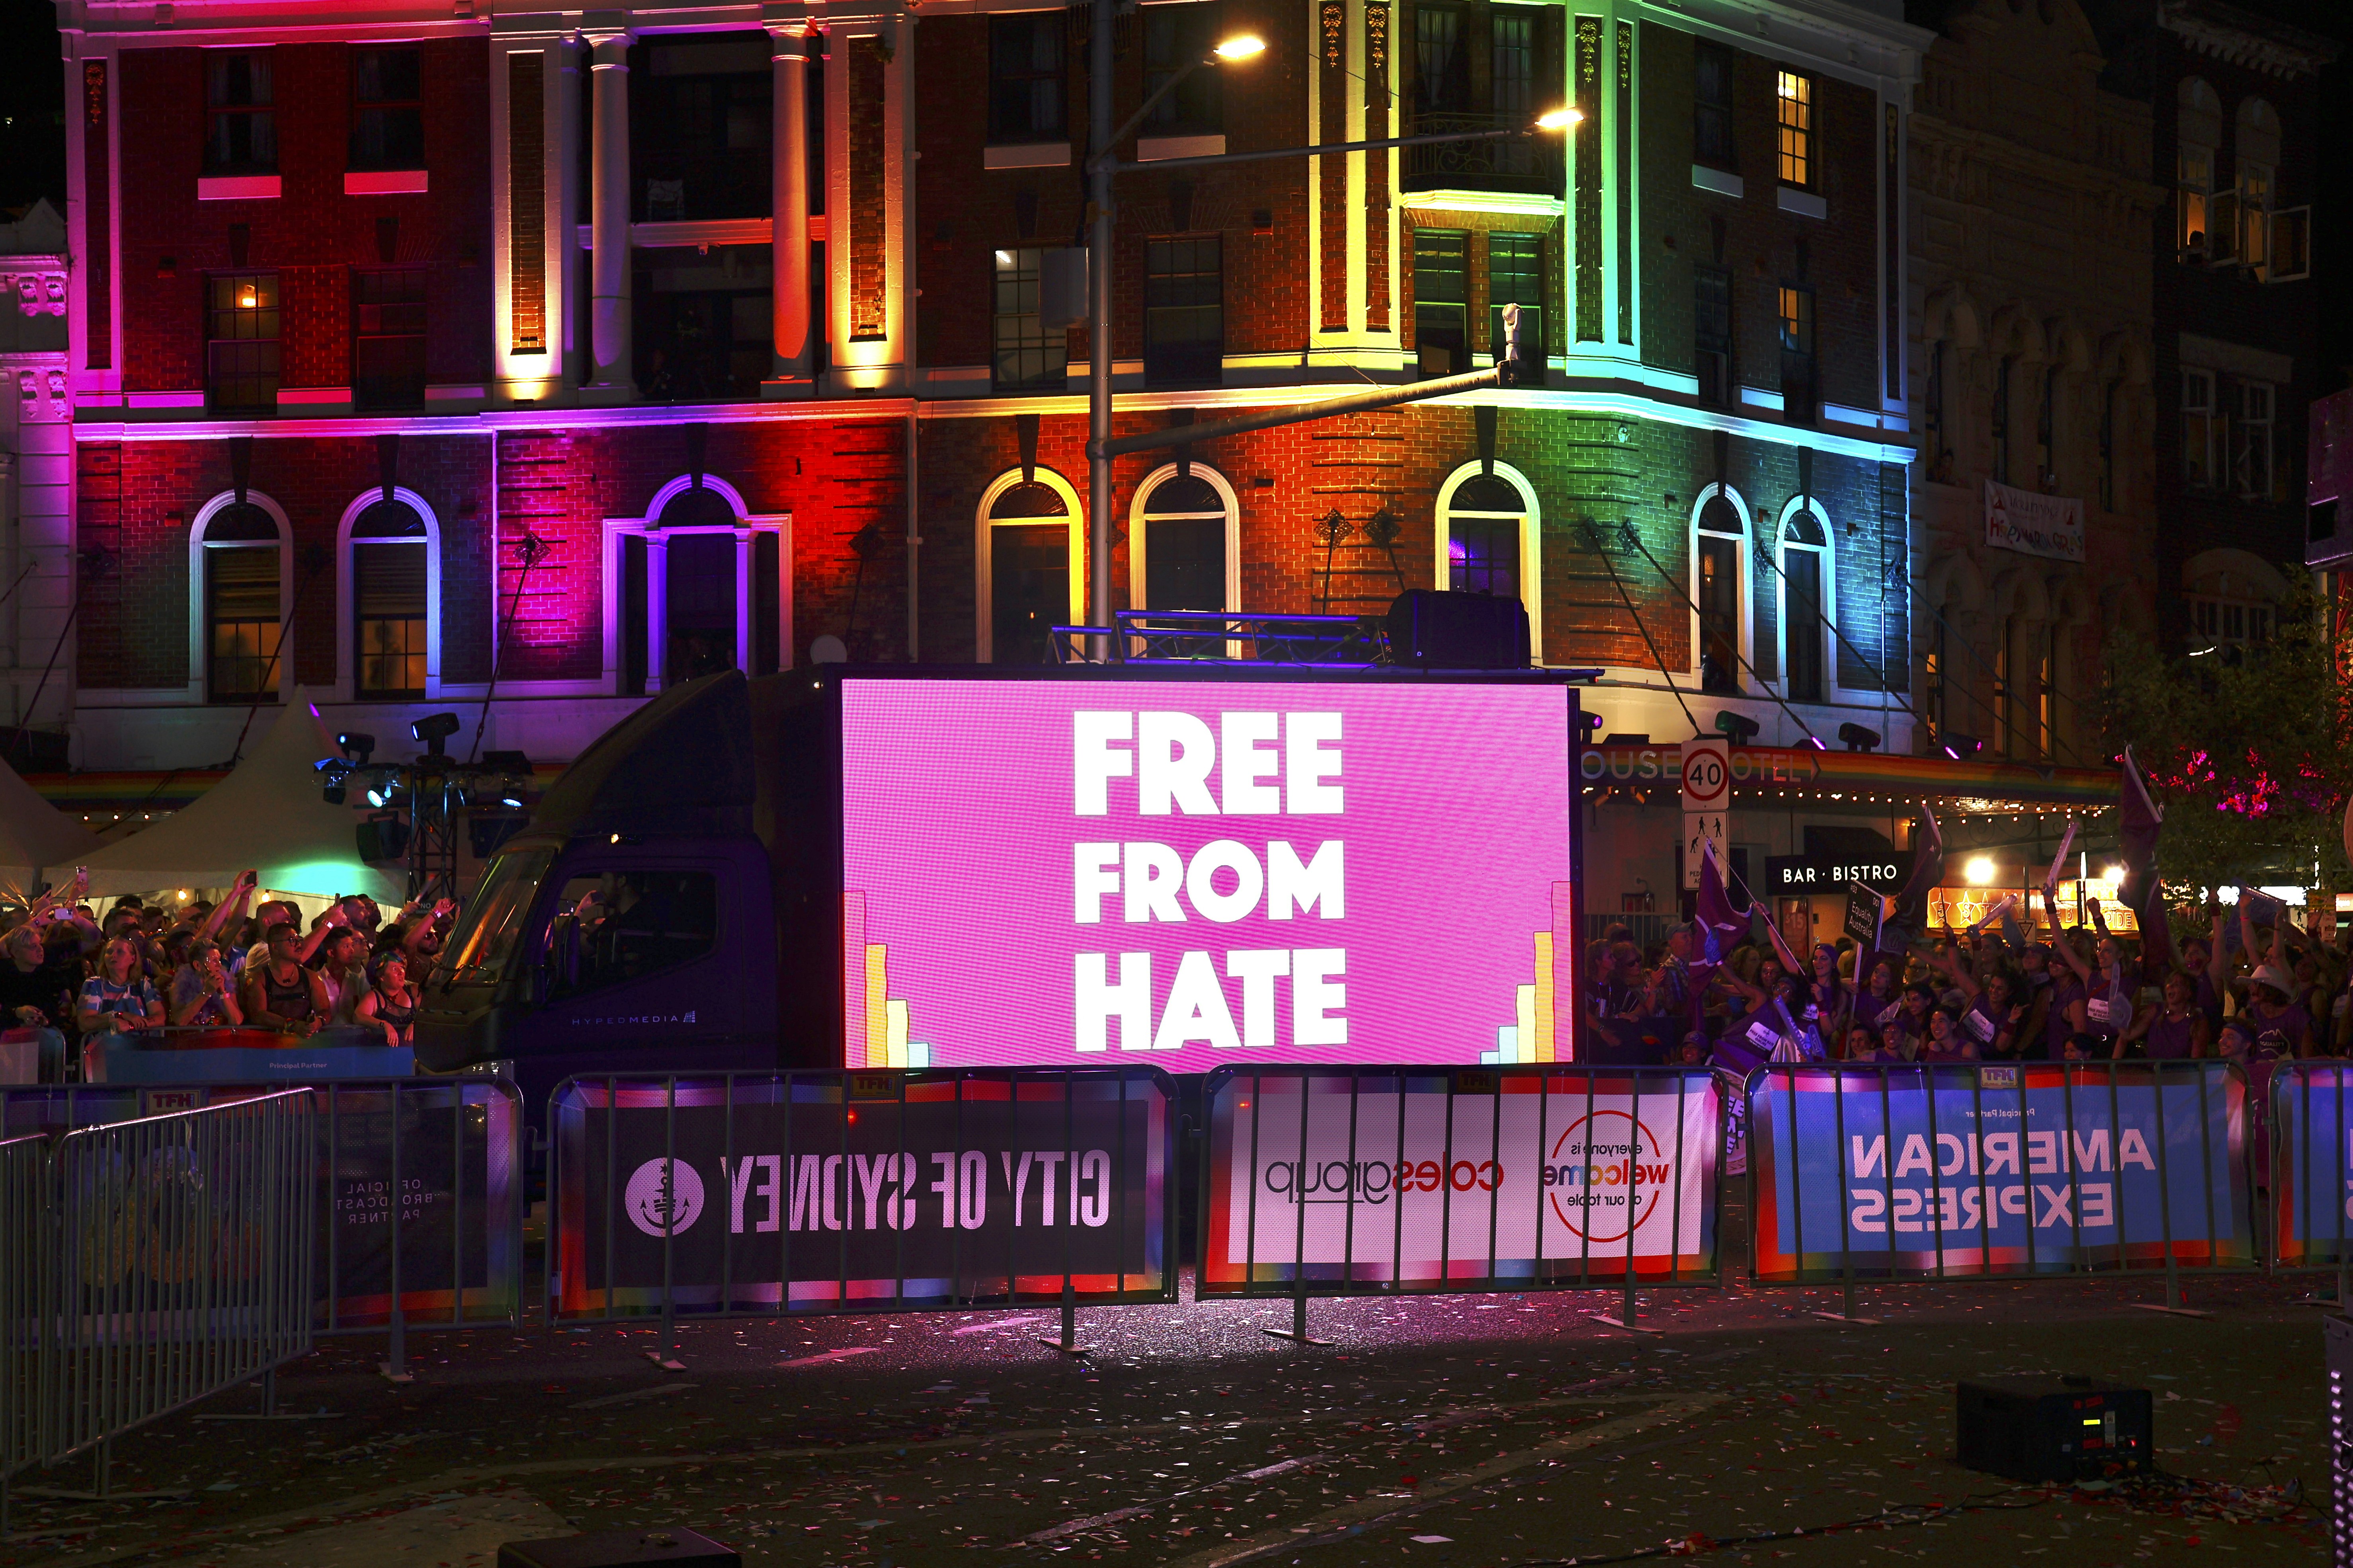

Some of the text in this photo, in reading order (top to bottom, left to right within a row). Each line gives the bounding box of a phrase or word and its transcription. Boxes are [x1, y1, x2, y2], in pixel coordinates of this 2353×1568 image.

[1074, 711, 1344, 815] FREE
[1689, 763, 1721, 786] 40
[1730, 752, 1801, 782] OTEL
[1074, 839, 1345, 924] FROM
[1783, 865, 1897, 883] BAR BISTRO
[1851, 901, 1874, 926] Equality
[2105, 910, 2132, 929] PIDE
[1849, 915, 1873, 939] Australia
[1075, 948, 1348, 1052] HATE
[856, 1077, 888, 1089] TFH
[1462, 1073, 1488, 1086] TFH
[1984, 1069, 2010, 1080] TFH
[153, 1093, 191, 1108] TFH
